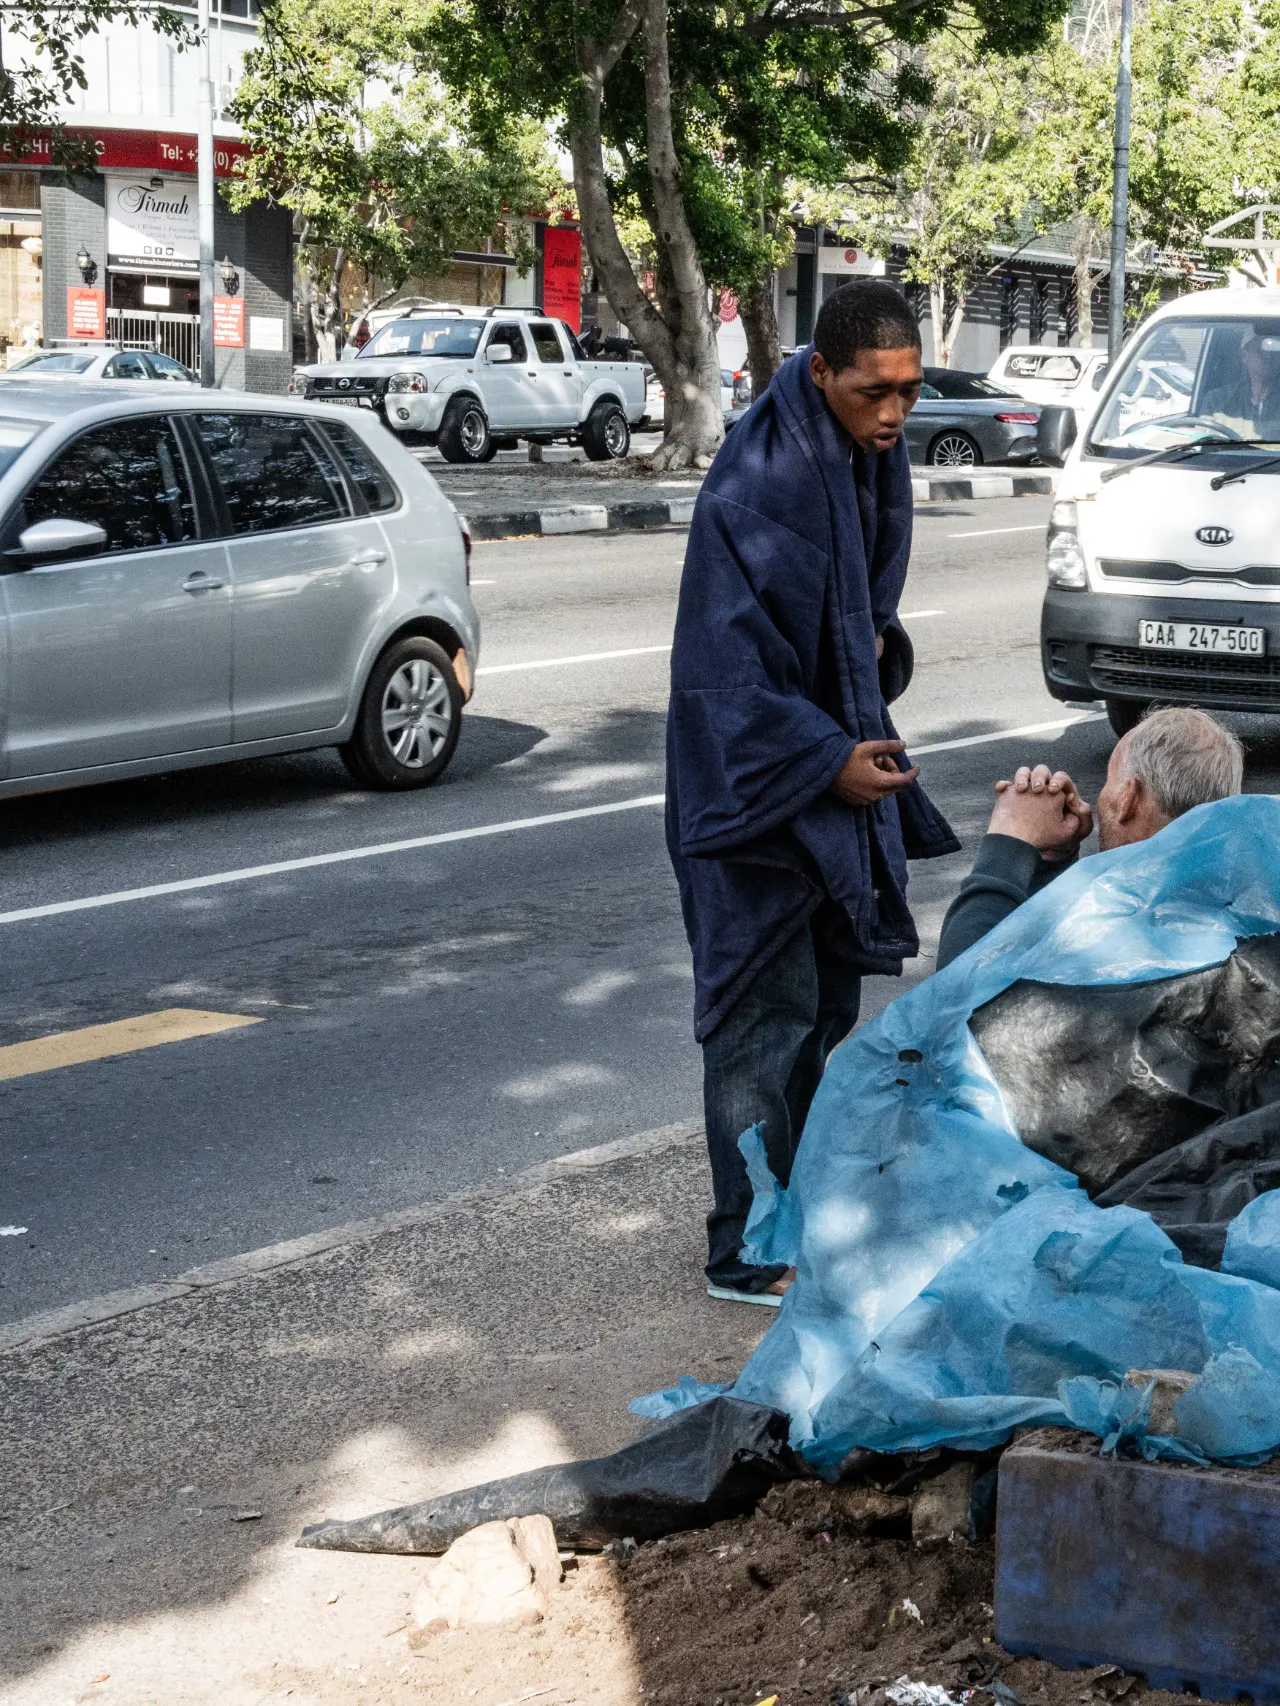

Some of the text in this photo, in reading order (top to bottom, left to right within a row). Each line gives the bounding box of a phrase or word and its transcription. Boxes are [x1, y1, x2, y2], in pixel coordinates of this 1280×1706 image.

[160, 143, 183, 160] Tel:
[213, 151, 229, 170] (0)
[117, 185, 189, 215] Tirmah
[1200, 529, 1228, 542] KIA
[1145, 623, 1259, 652] CAA 247-500
